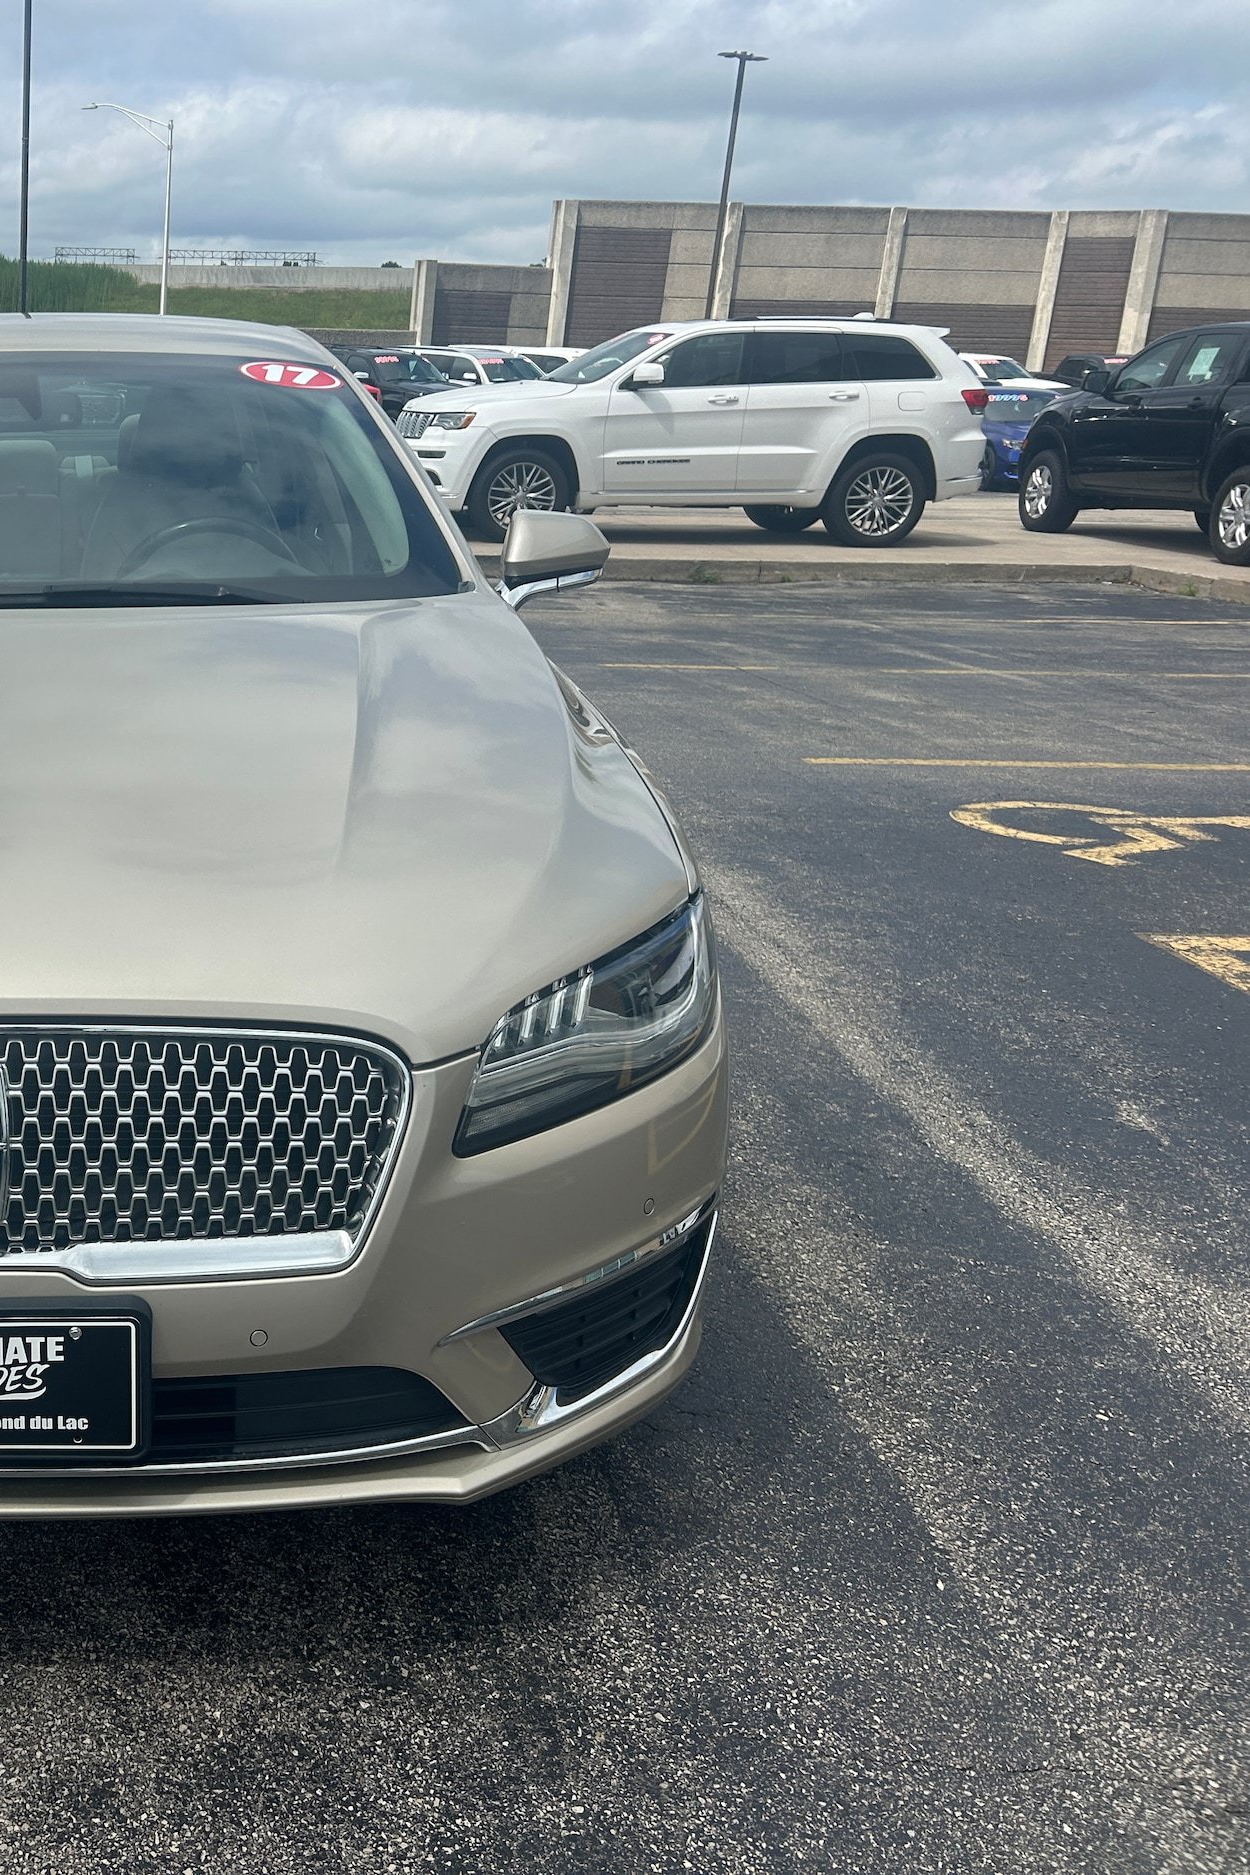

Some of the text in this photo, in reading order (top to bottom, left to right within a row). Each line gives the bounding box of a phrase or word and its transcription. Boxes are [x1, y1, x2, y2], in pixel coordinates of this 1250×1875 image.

[261, 365, 319, 385] 17
[30, 1416, 53, 1430] du
[57, 1416, 89, 1430] Lac
